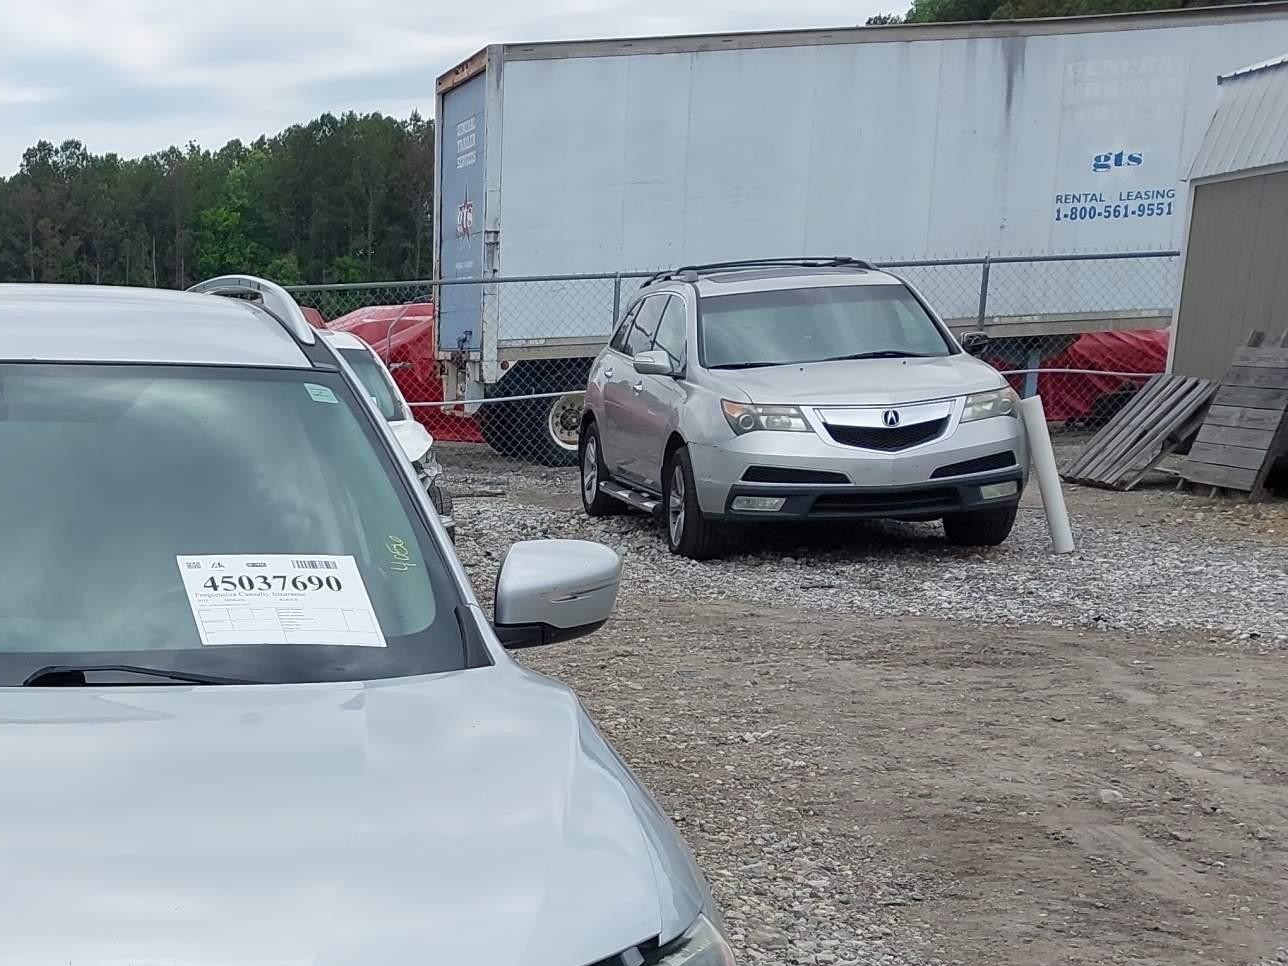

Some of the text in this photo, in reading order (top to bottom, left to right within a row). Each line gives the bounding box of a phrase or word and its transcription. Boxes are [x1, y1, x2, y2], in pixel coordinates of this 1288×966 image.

[1092, 150, 1143, 173] gts
[1055, 189, 1176, 204] RENTAL LEASING
[1055, 202, 1173, 222] 1-800-561-9551
[203, 575, 343, 592] 45037690
